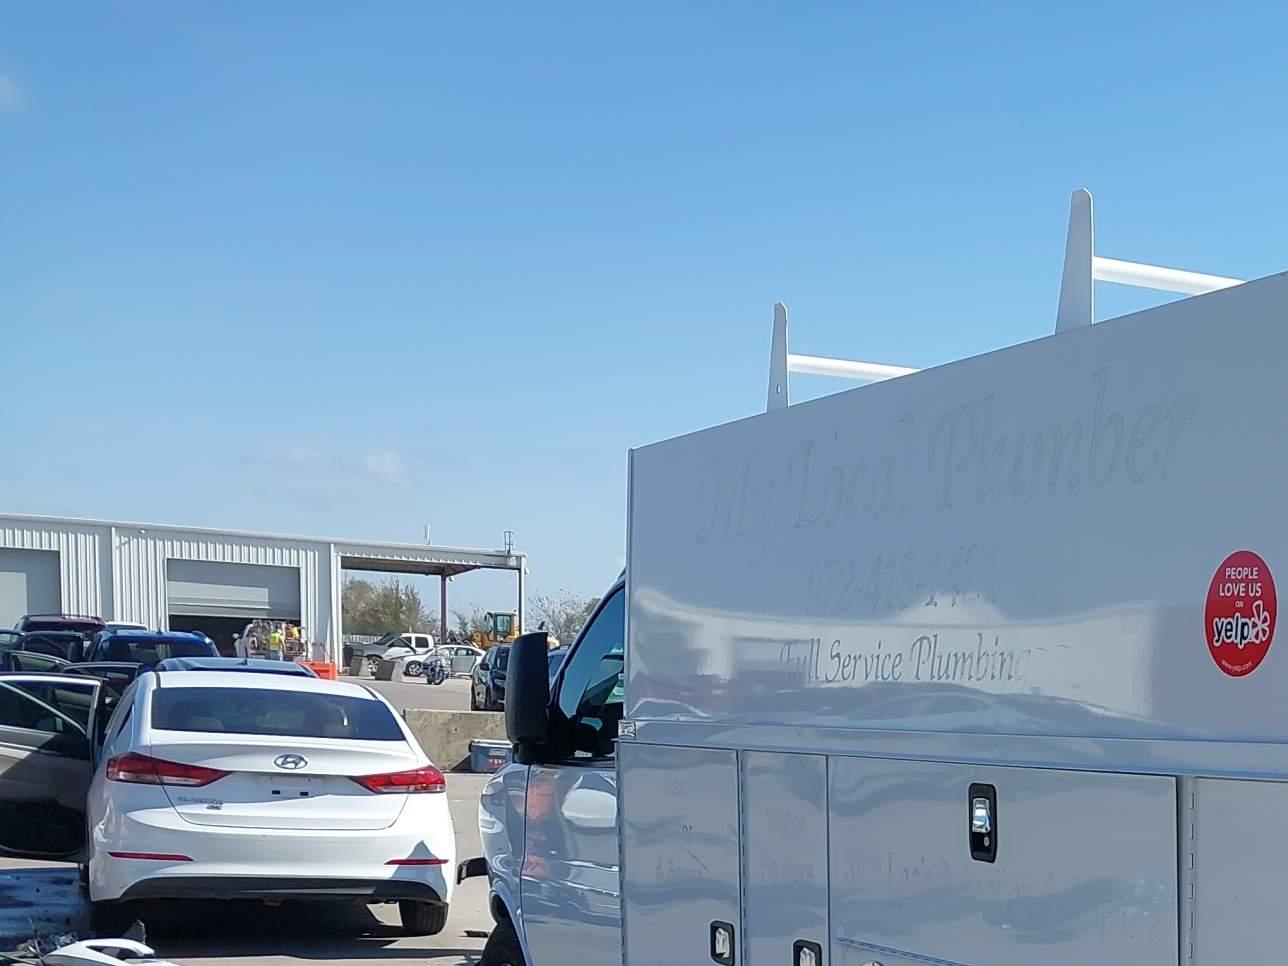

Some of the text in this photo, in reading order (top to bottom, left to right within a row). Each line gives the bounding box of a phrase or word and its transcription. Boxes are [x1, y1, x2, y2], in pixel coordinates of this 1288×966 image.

[1225, 567, 1259, 580] PEOPLE
[1219, 583, 1262, 597] LOVE US
[1213, 613, 1251, 648] yelp
[825, 639, 903, 683] Service
